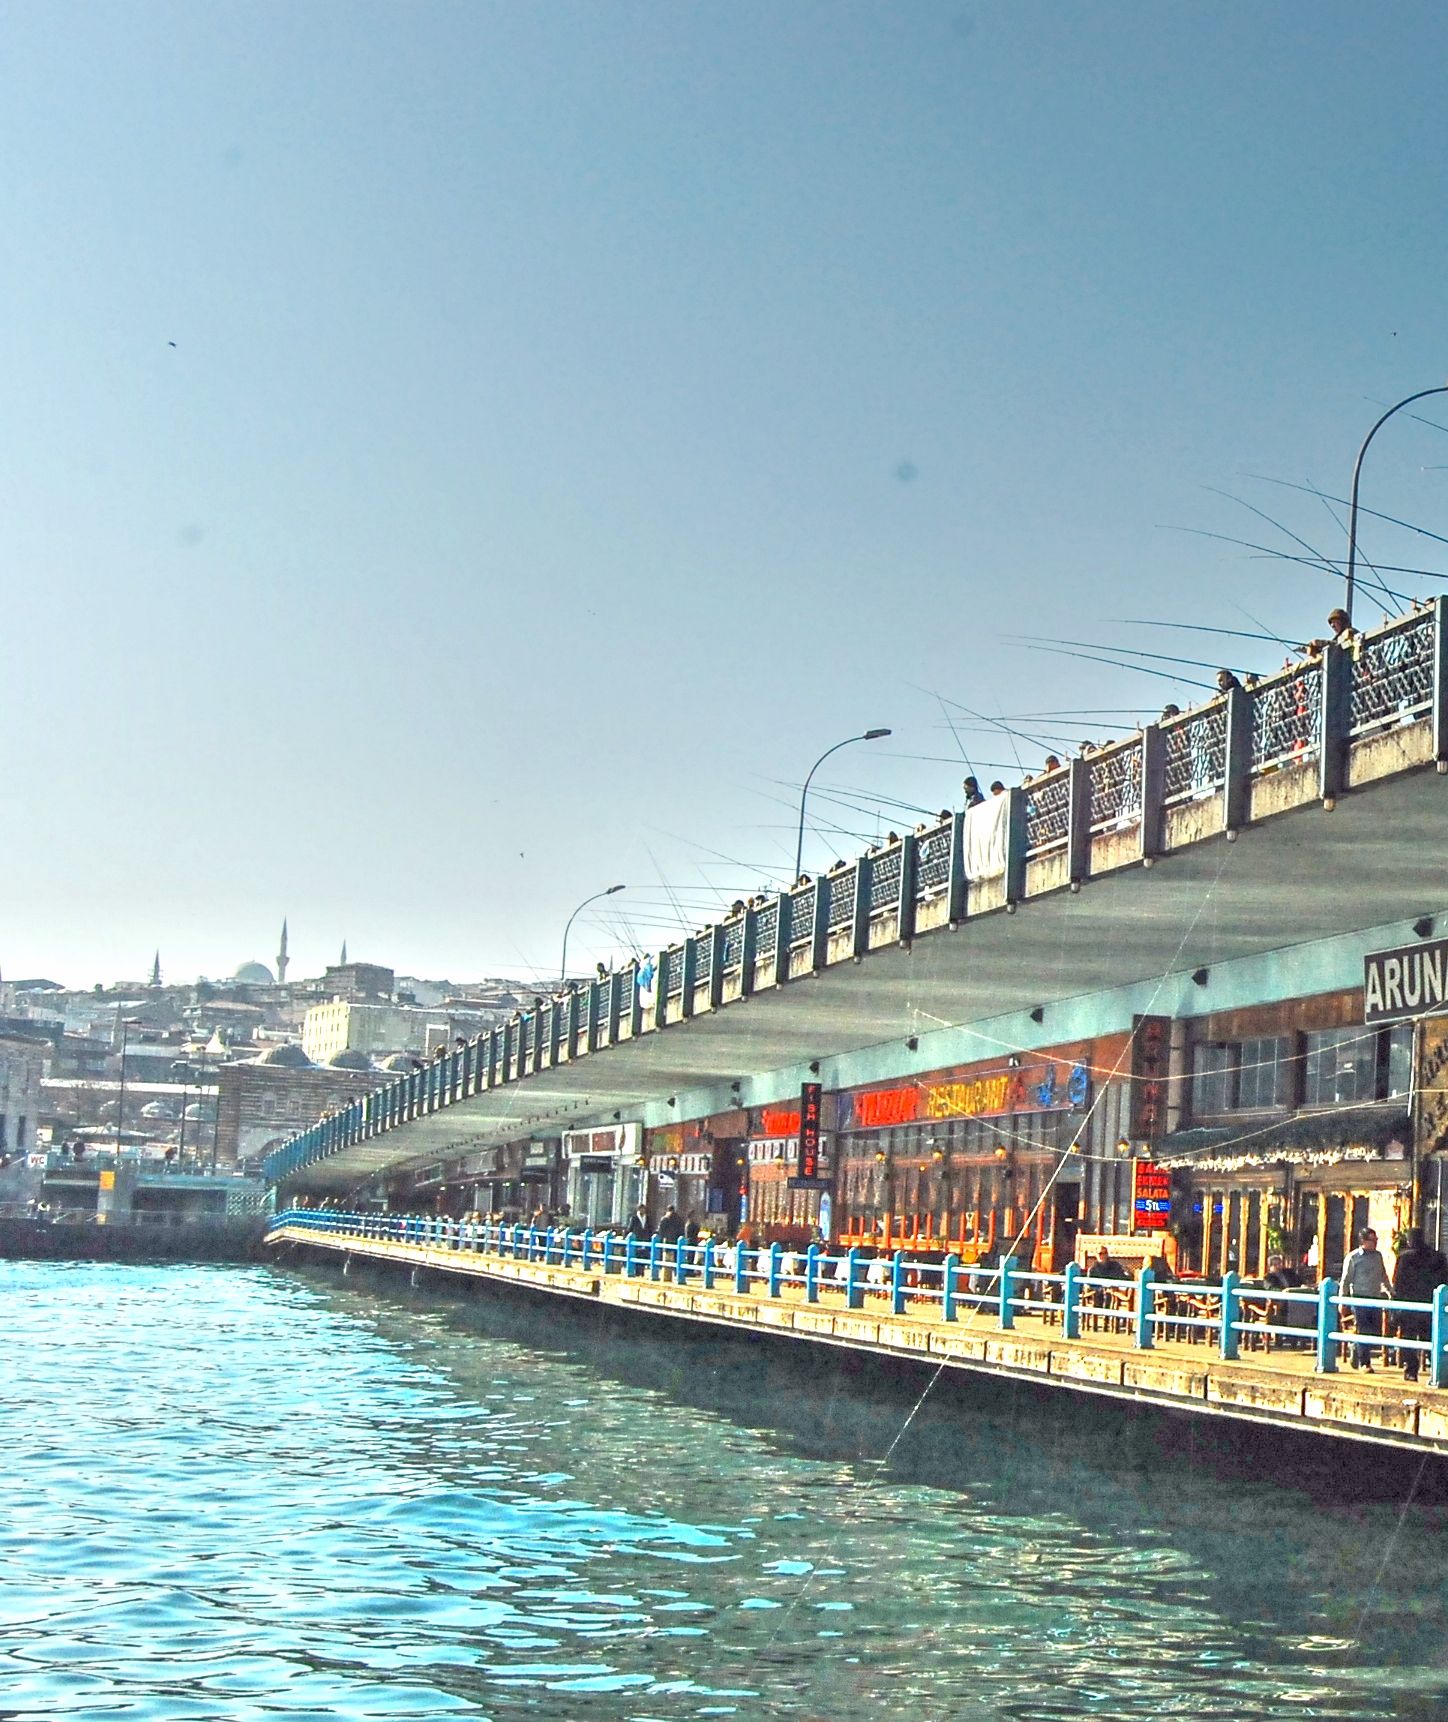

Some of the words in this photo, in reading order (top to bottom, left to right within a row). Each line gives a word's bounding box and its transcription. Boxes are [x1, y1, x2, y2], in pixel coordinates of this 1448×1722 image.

[806, 1085, 817, 1120] FISH
[926, 1075, 1009, 1118] RESTAURANT
[31, 1156, 45, 1164] WC
[804, 1128, 816, 1175] HOUSE
[1136, 1188, 1169, 1198] SALATA
